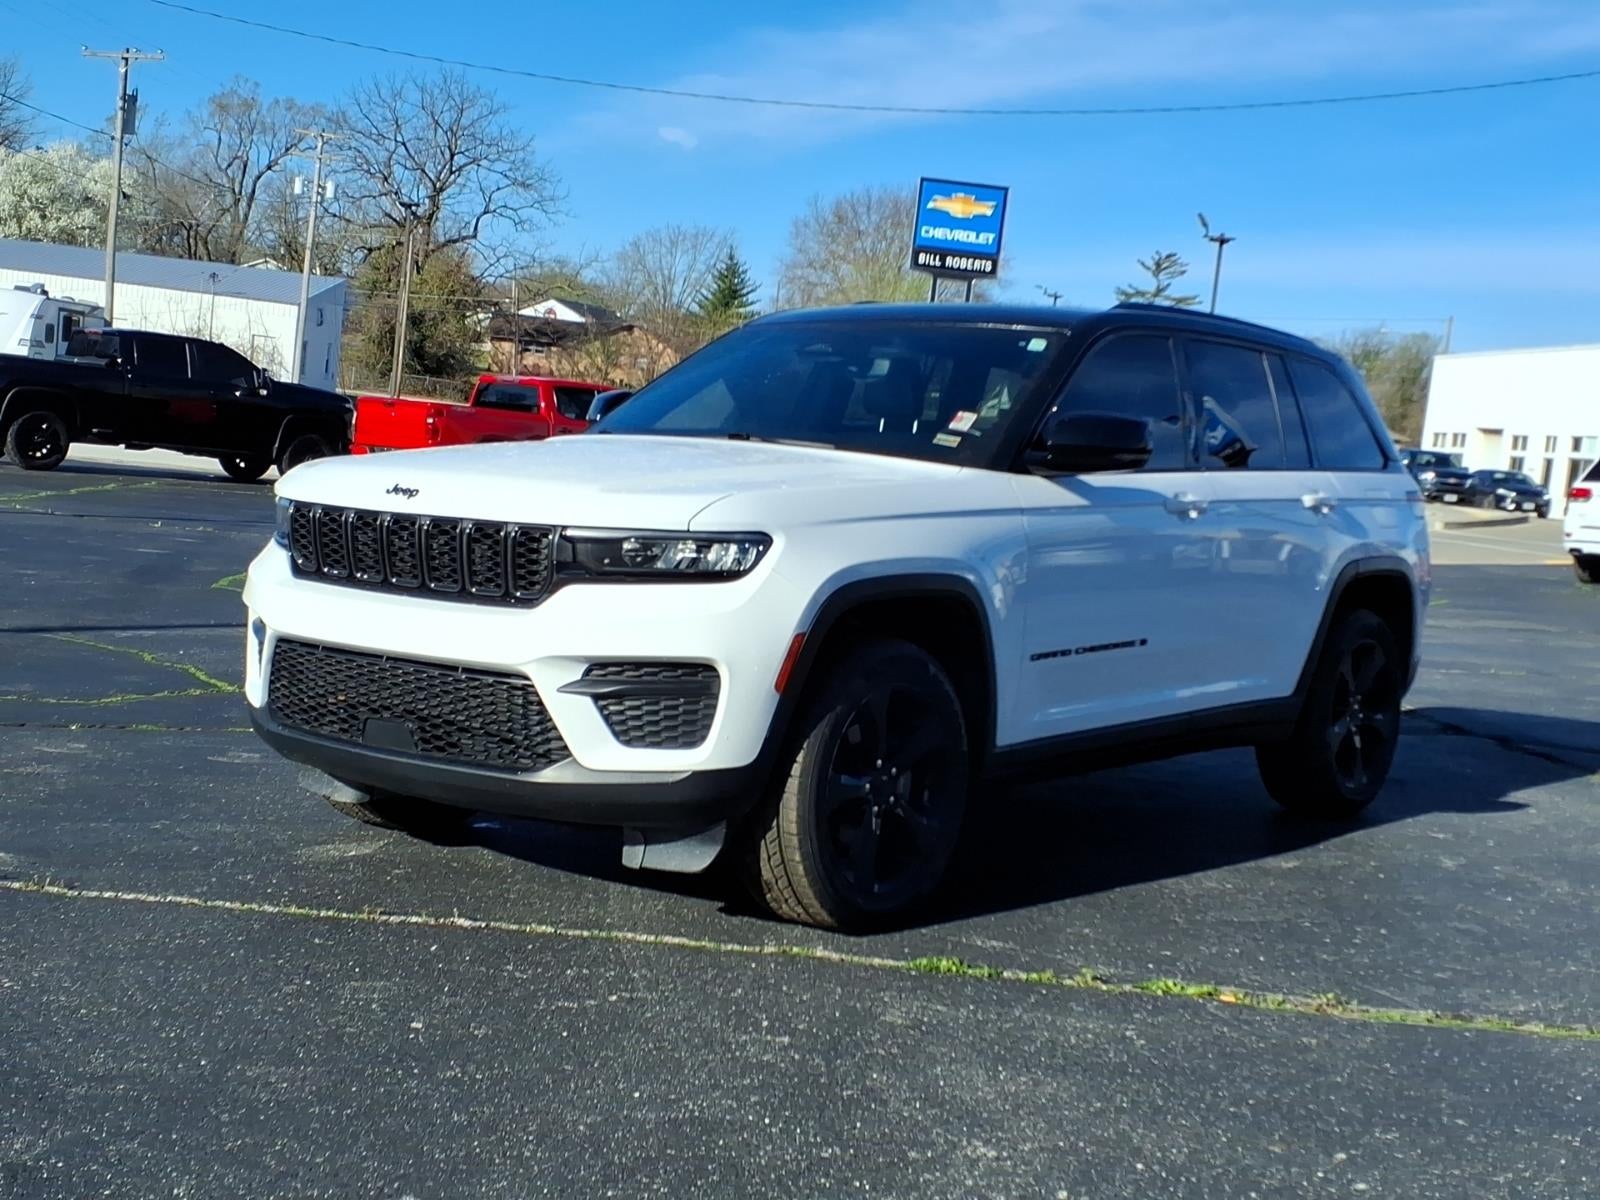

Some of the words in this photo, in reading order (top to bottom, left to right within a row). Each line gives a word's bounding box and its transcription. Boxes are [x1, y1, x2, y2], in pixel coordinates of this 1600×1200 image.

[921, 226, 995, 245] CHEVROLET
[918, 252, 941, 267] BILL
[945, 255, 992, 273] ROBERTS
[386, 483, 419, 500] Jeep
